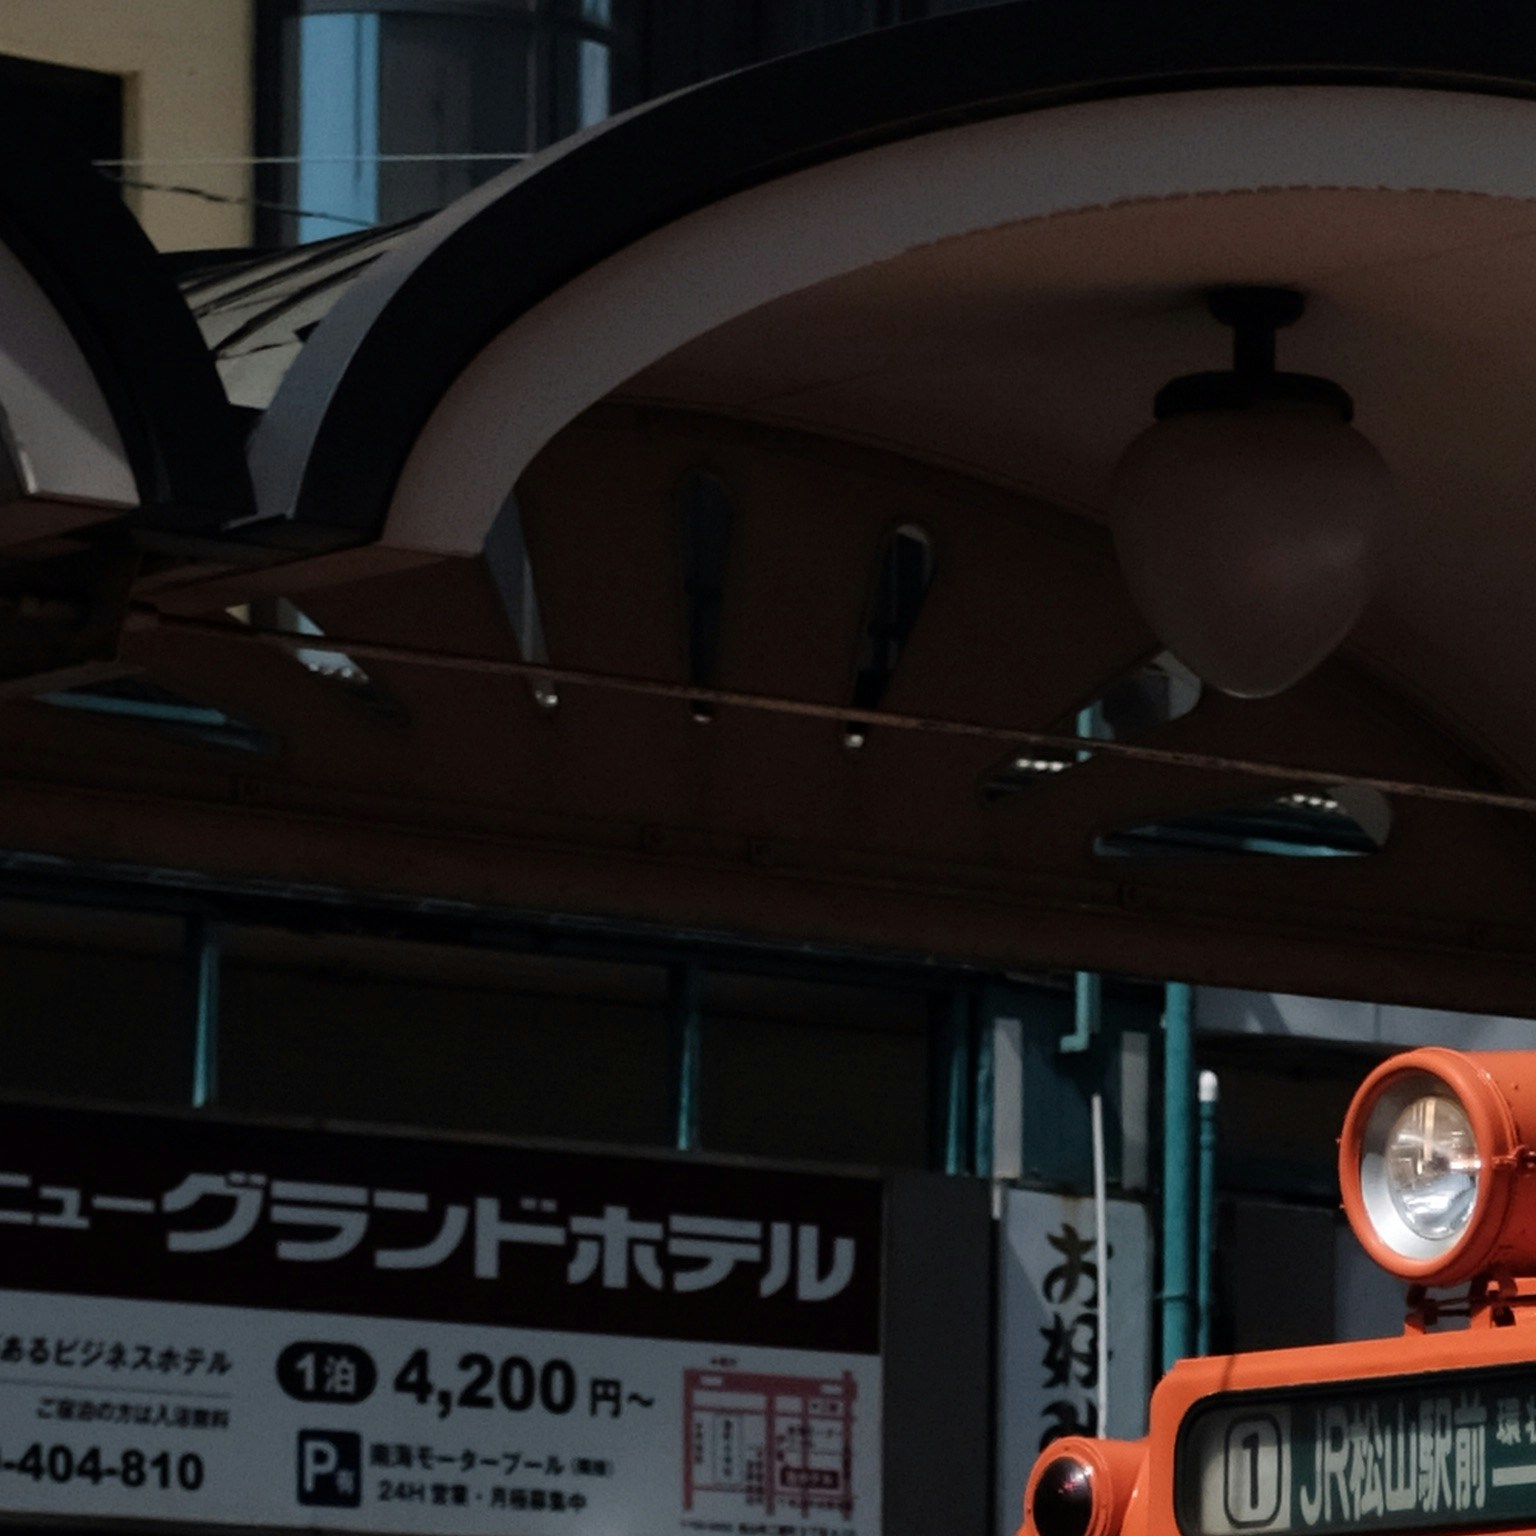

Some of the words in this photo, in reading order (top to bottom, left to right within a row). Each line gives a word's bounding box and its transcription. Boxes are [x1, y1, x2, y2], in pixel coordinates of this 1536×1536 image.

[0, 1441, 205, 1492] -404-810
[1300, 1392, 1488, 1526] JR松山駅前
